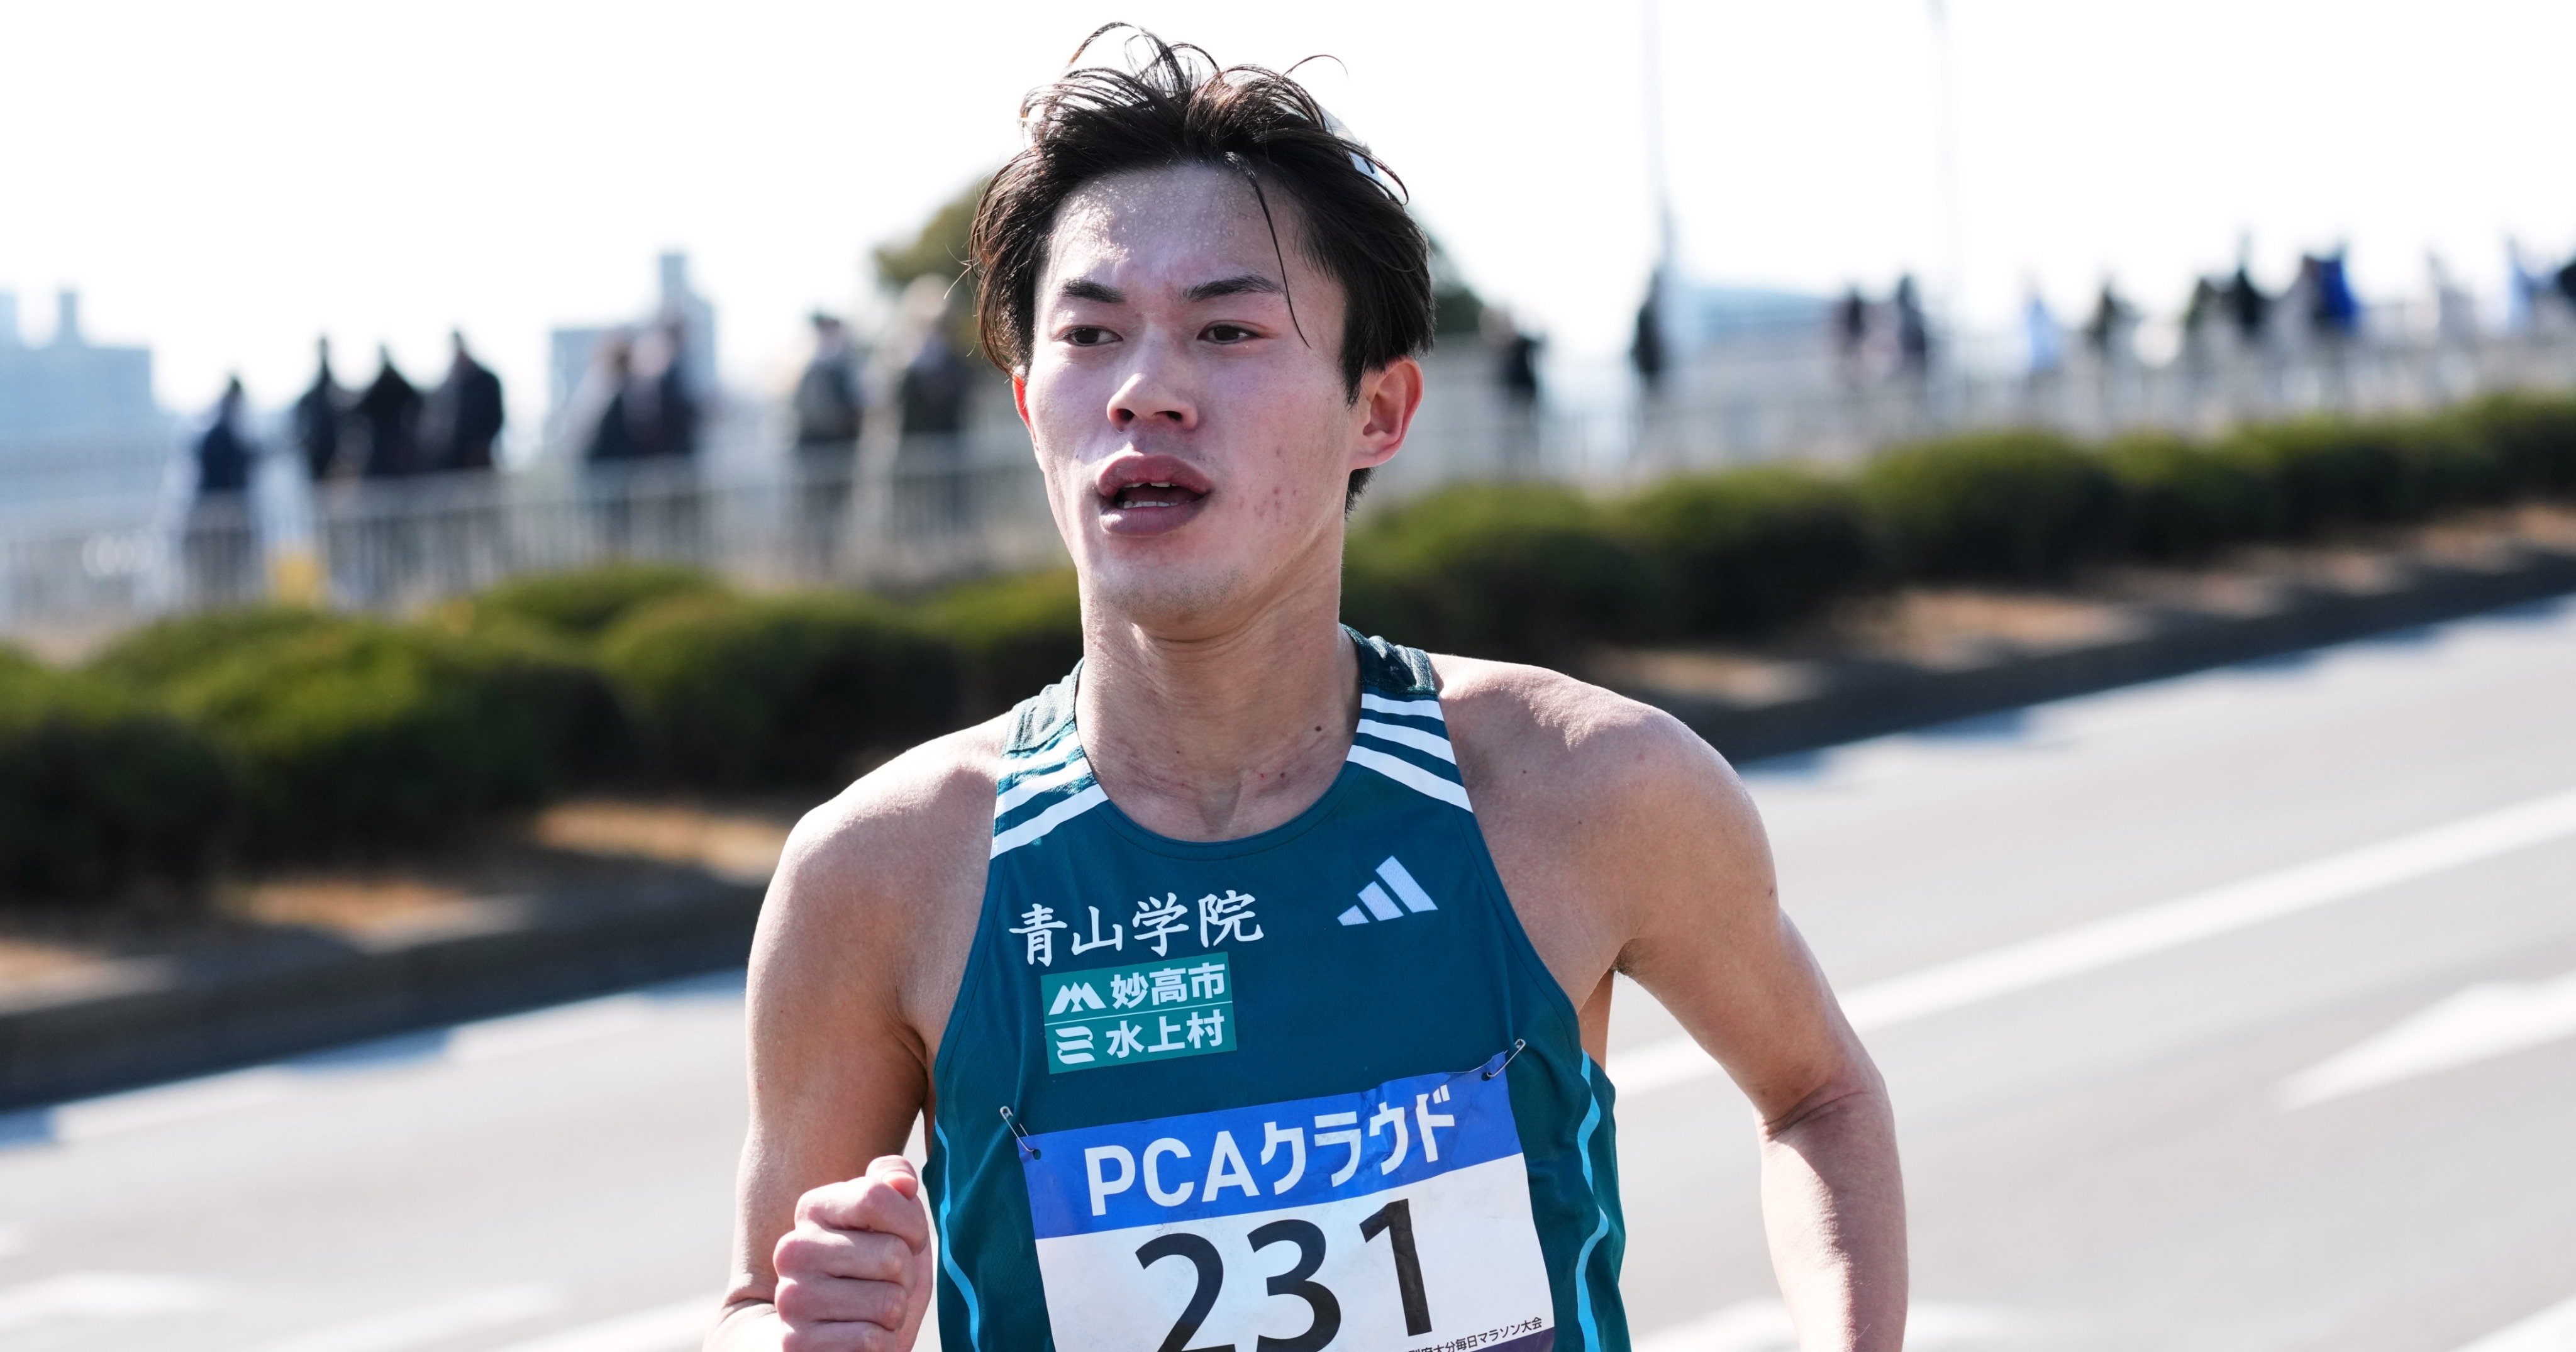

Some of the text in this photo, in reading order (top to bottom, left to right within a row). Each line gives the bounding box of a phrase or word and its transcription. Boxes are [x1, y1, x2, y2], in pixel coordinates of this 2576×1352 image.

[1009, 890, 1264, 967] 青山学院
[1110, 962, 1225, 1009] 妙高市
[1106, 1009, 1224, 1058] 水上村
[1084, 1084, 1455, 1216] PCAクラウド
[1135, 1198, 1432, 1352] 231
